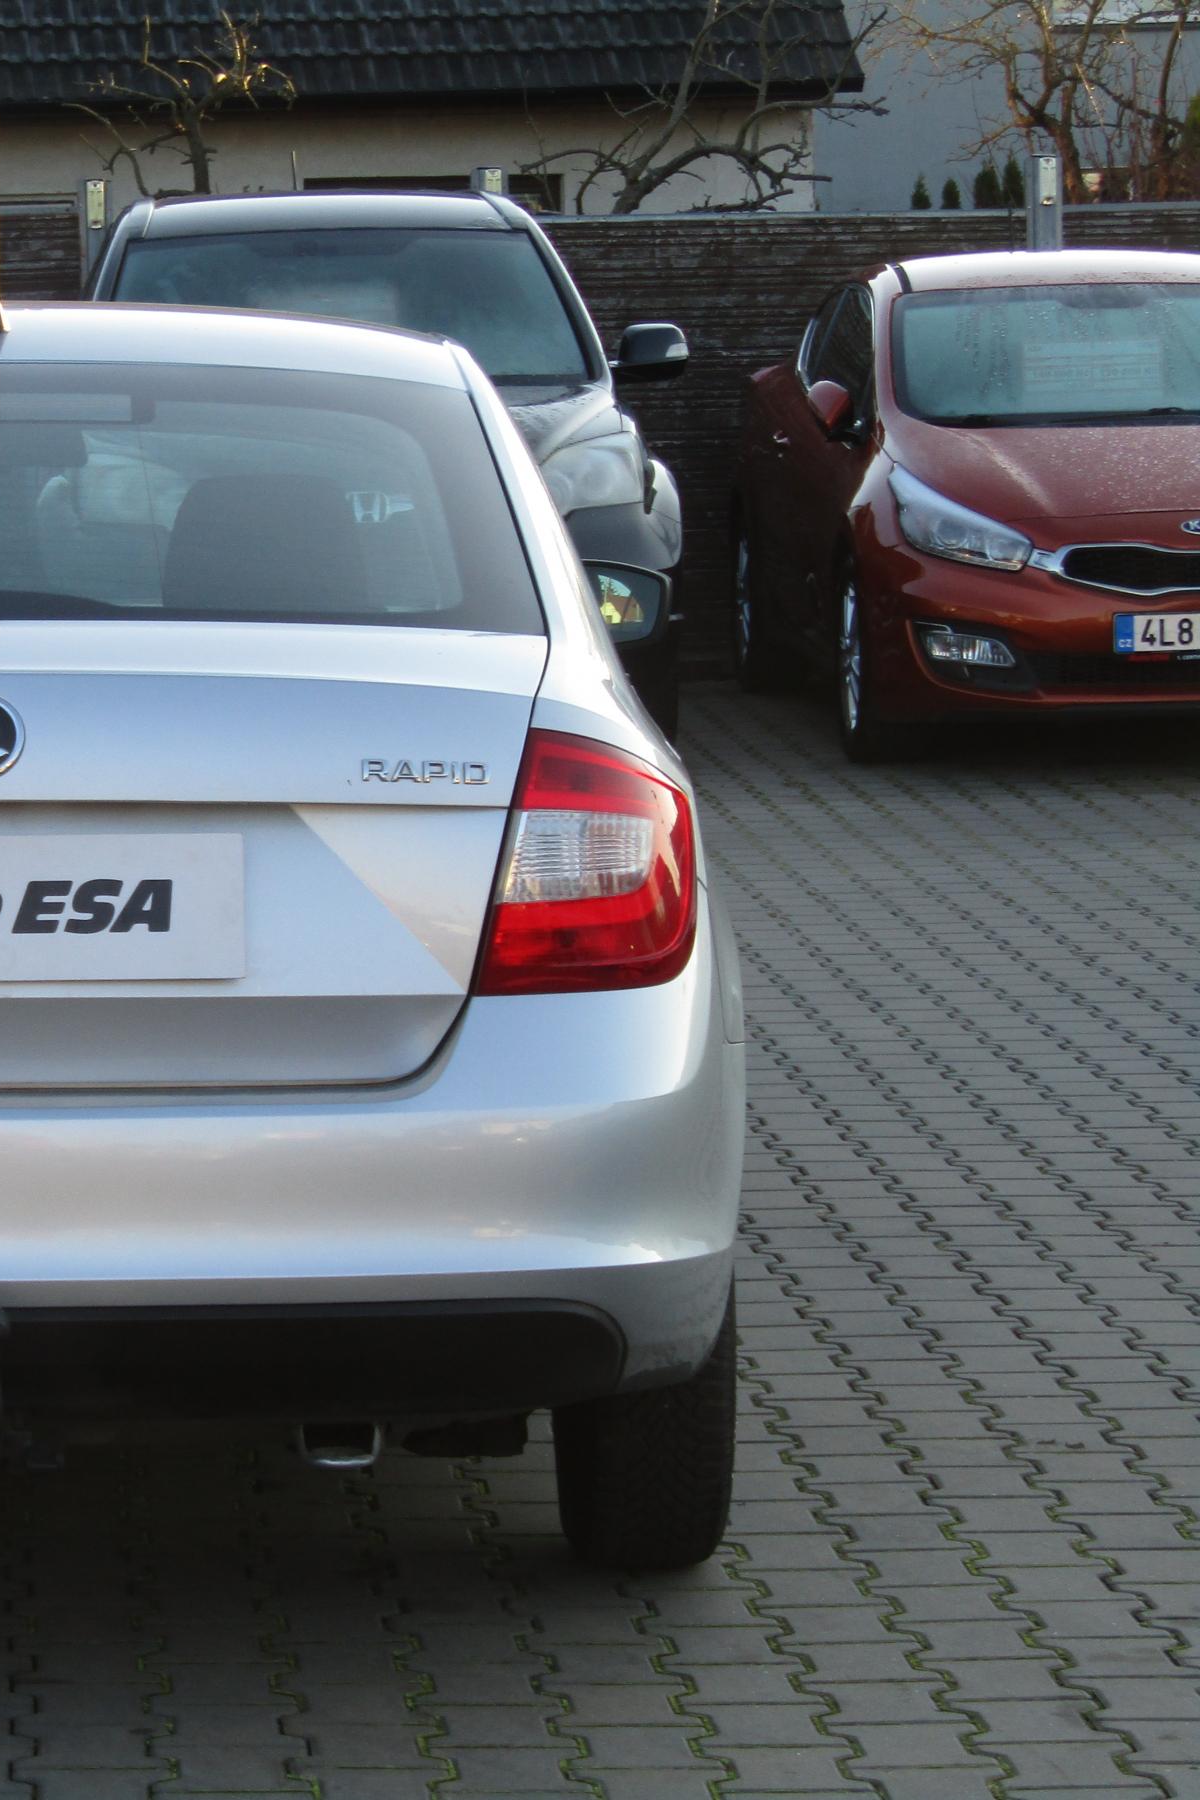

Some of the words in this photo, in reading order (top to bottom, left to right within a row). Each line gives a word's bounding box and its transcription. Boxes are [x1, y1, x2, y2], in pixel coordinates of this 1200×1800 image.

[1141, 618, 1193, 647] 4L8
[361, 758, 490, 785] RAPID
[11, 879, 173, 934] ESA
